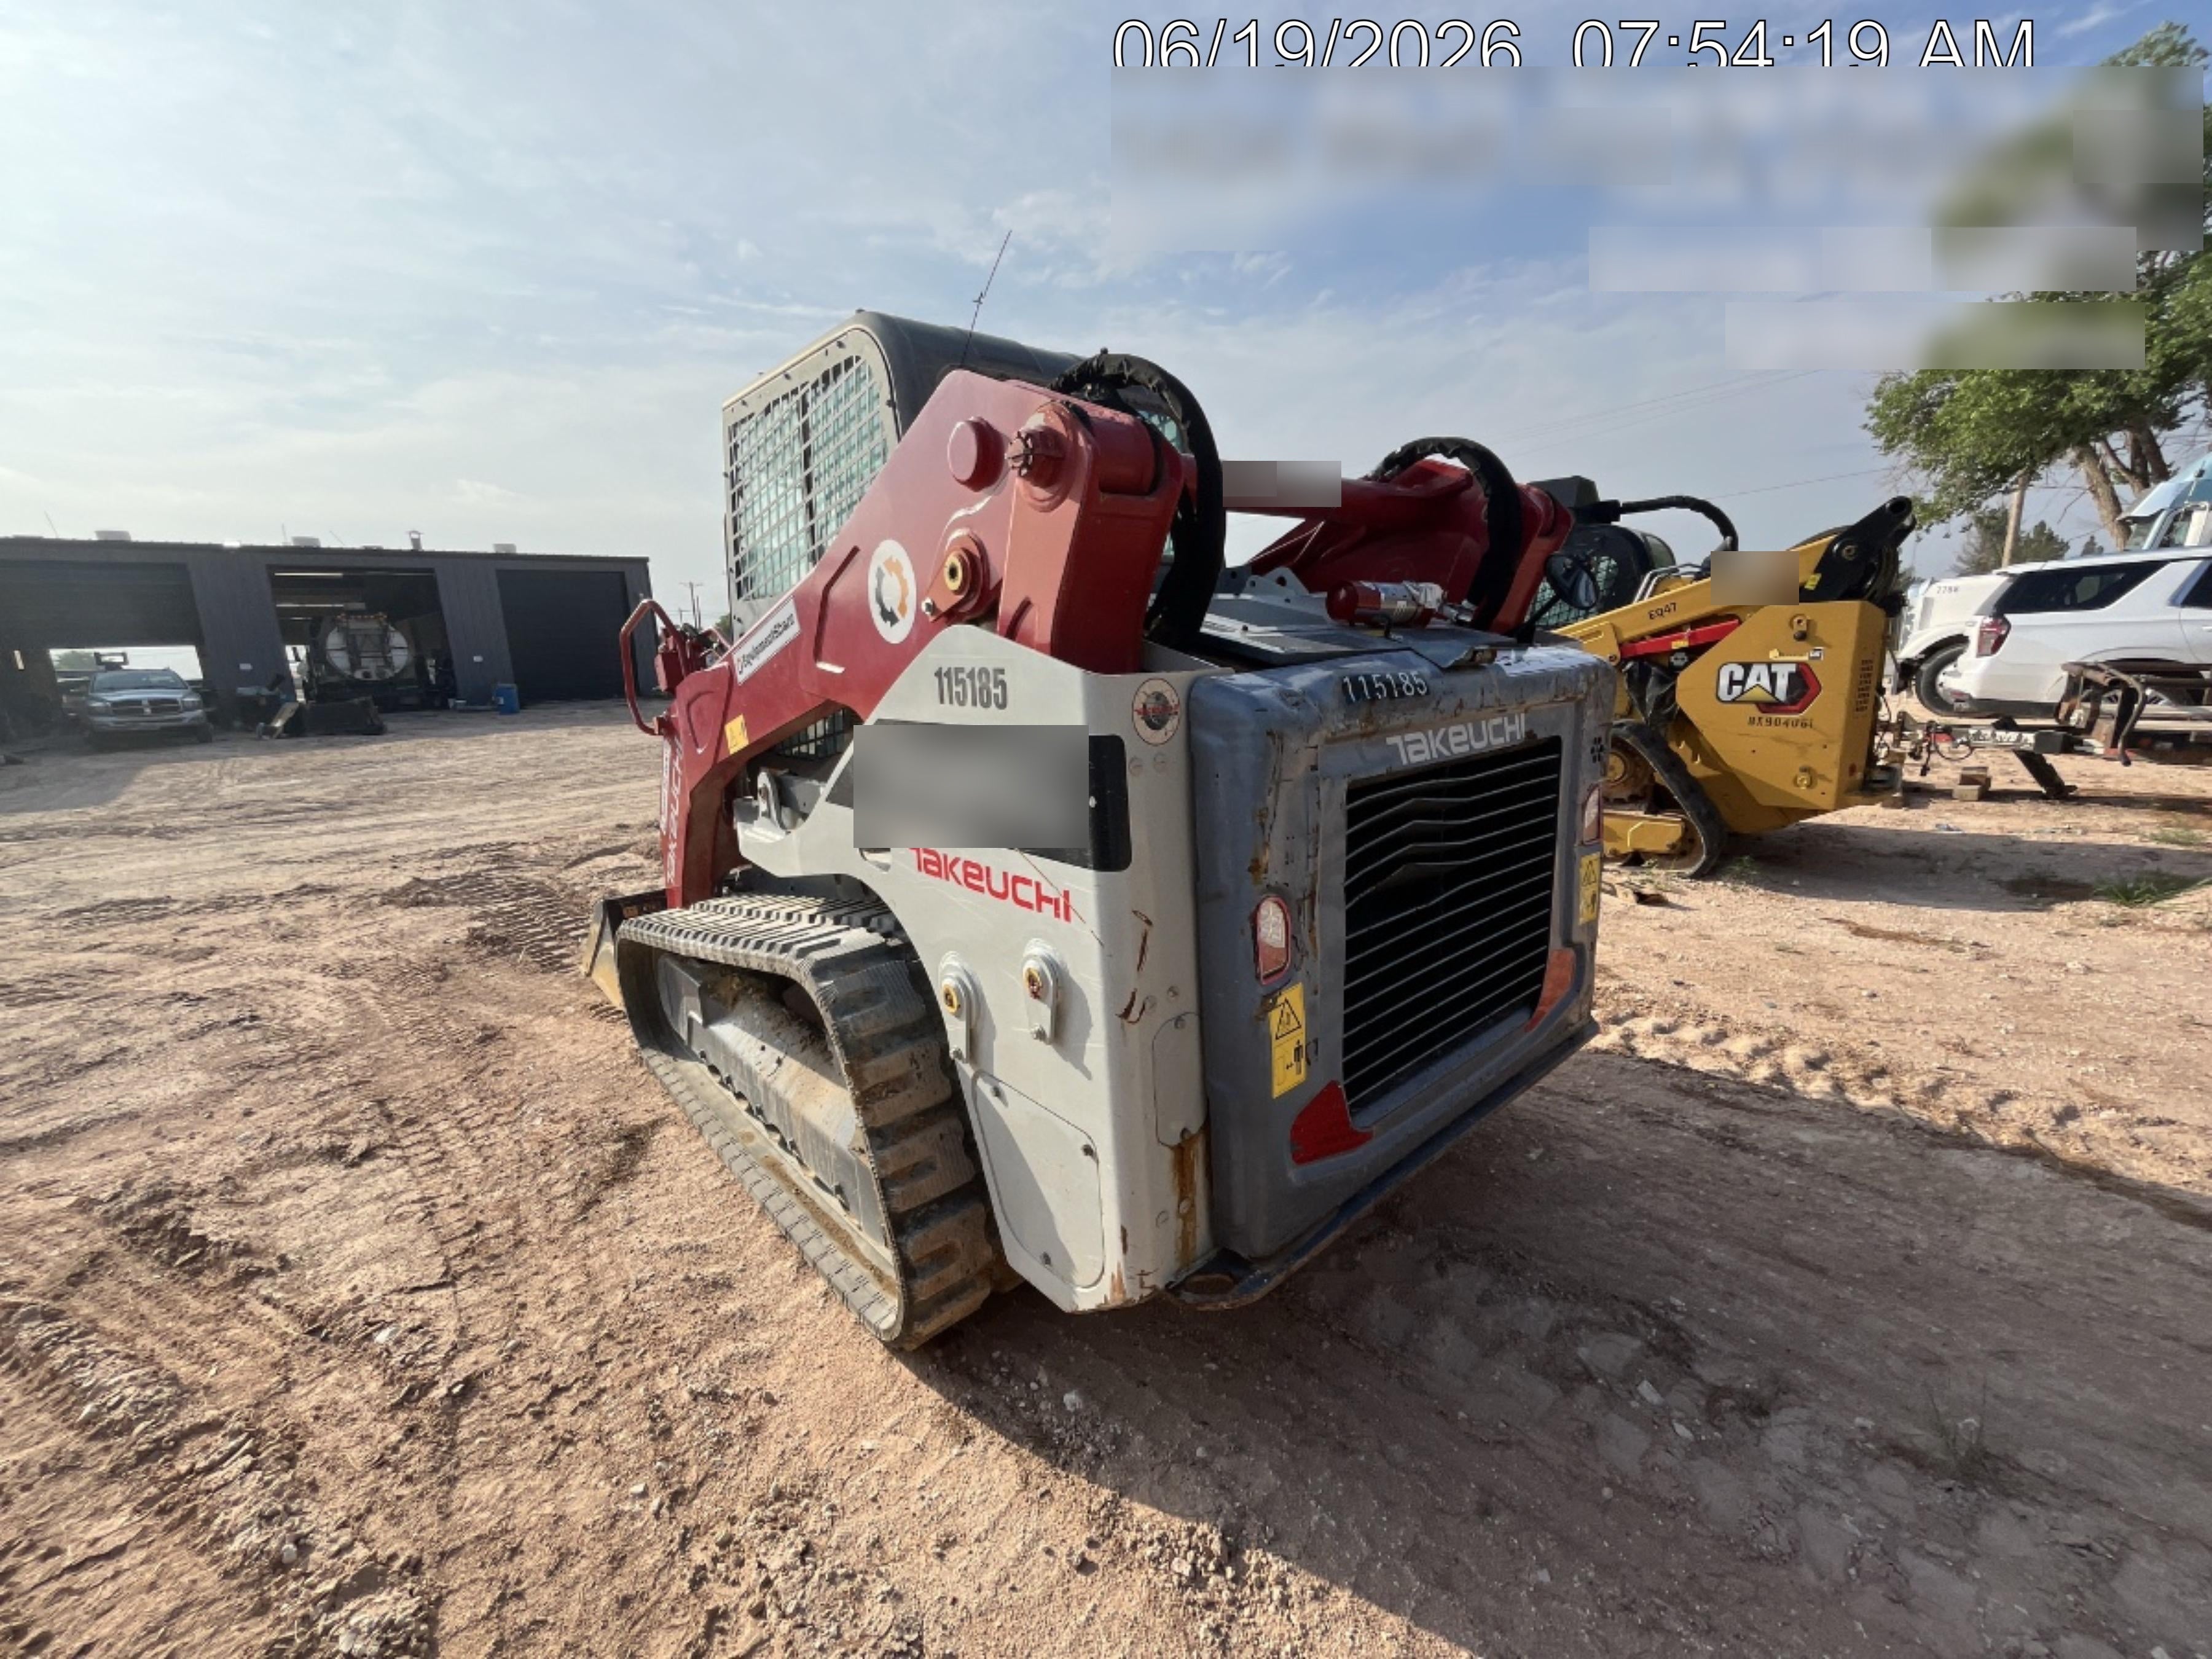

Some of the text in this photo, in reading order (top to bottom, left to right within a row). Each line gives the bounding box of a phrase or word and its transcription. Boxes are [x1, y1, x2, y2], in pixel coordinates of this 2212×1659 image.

[934, 667, 1008, 710] 115185
[1343, 670, 1427, 702] 115185
[1717, 663, 1797, 702] CAT
[1386, 713, 1526, 765] TAKEUCHI
[908, 847, 1072, 922] TAKEUCHI
